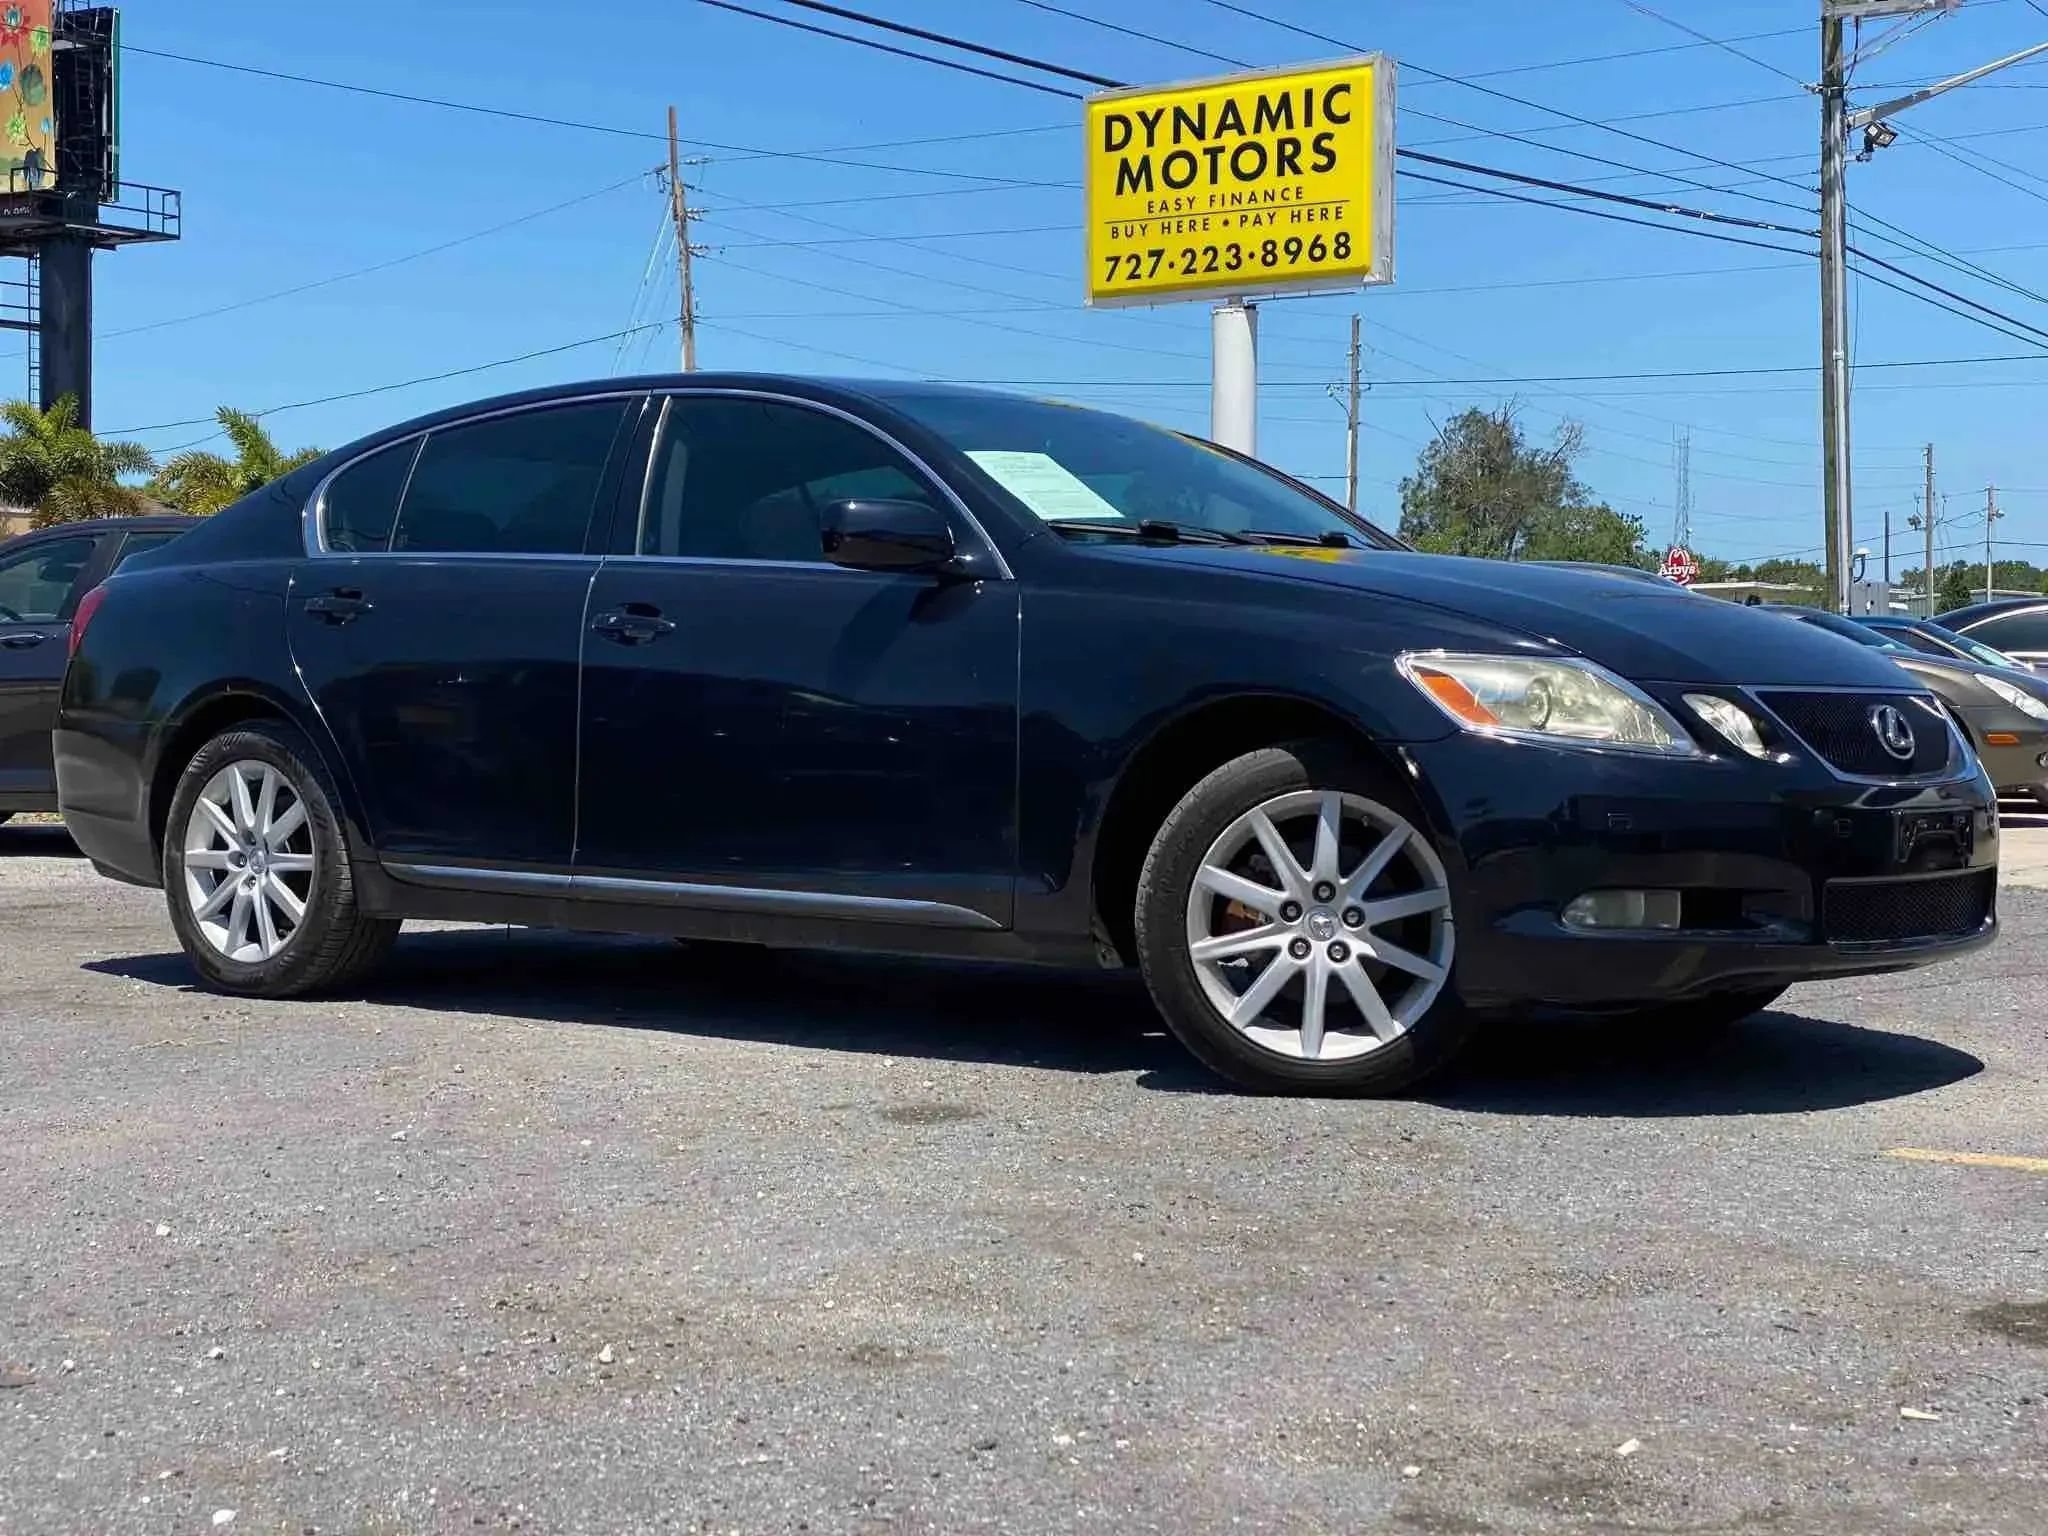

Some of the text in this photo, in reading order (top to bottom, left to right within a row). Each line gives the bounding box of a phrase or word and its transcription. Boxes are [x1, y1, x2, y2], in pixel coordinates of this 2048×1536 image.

[1105, 84, 1351, 152] DYNAMIC
[1116, 132, 1336, 195] MOTORS
[1111, 206, 1343, 239] BUY HERE PAY HERE
[1147, 187, 1303, 213] EASY FINANCE
